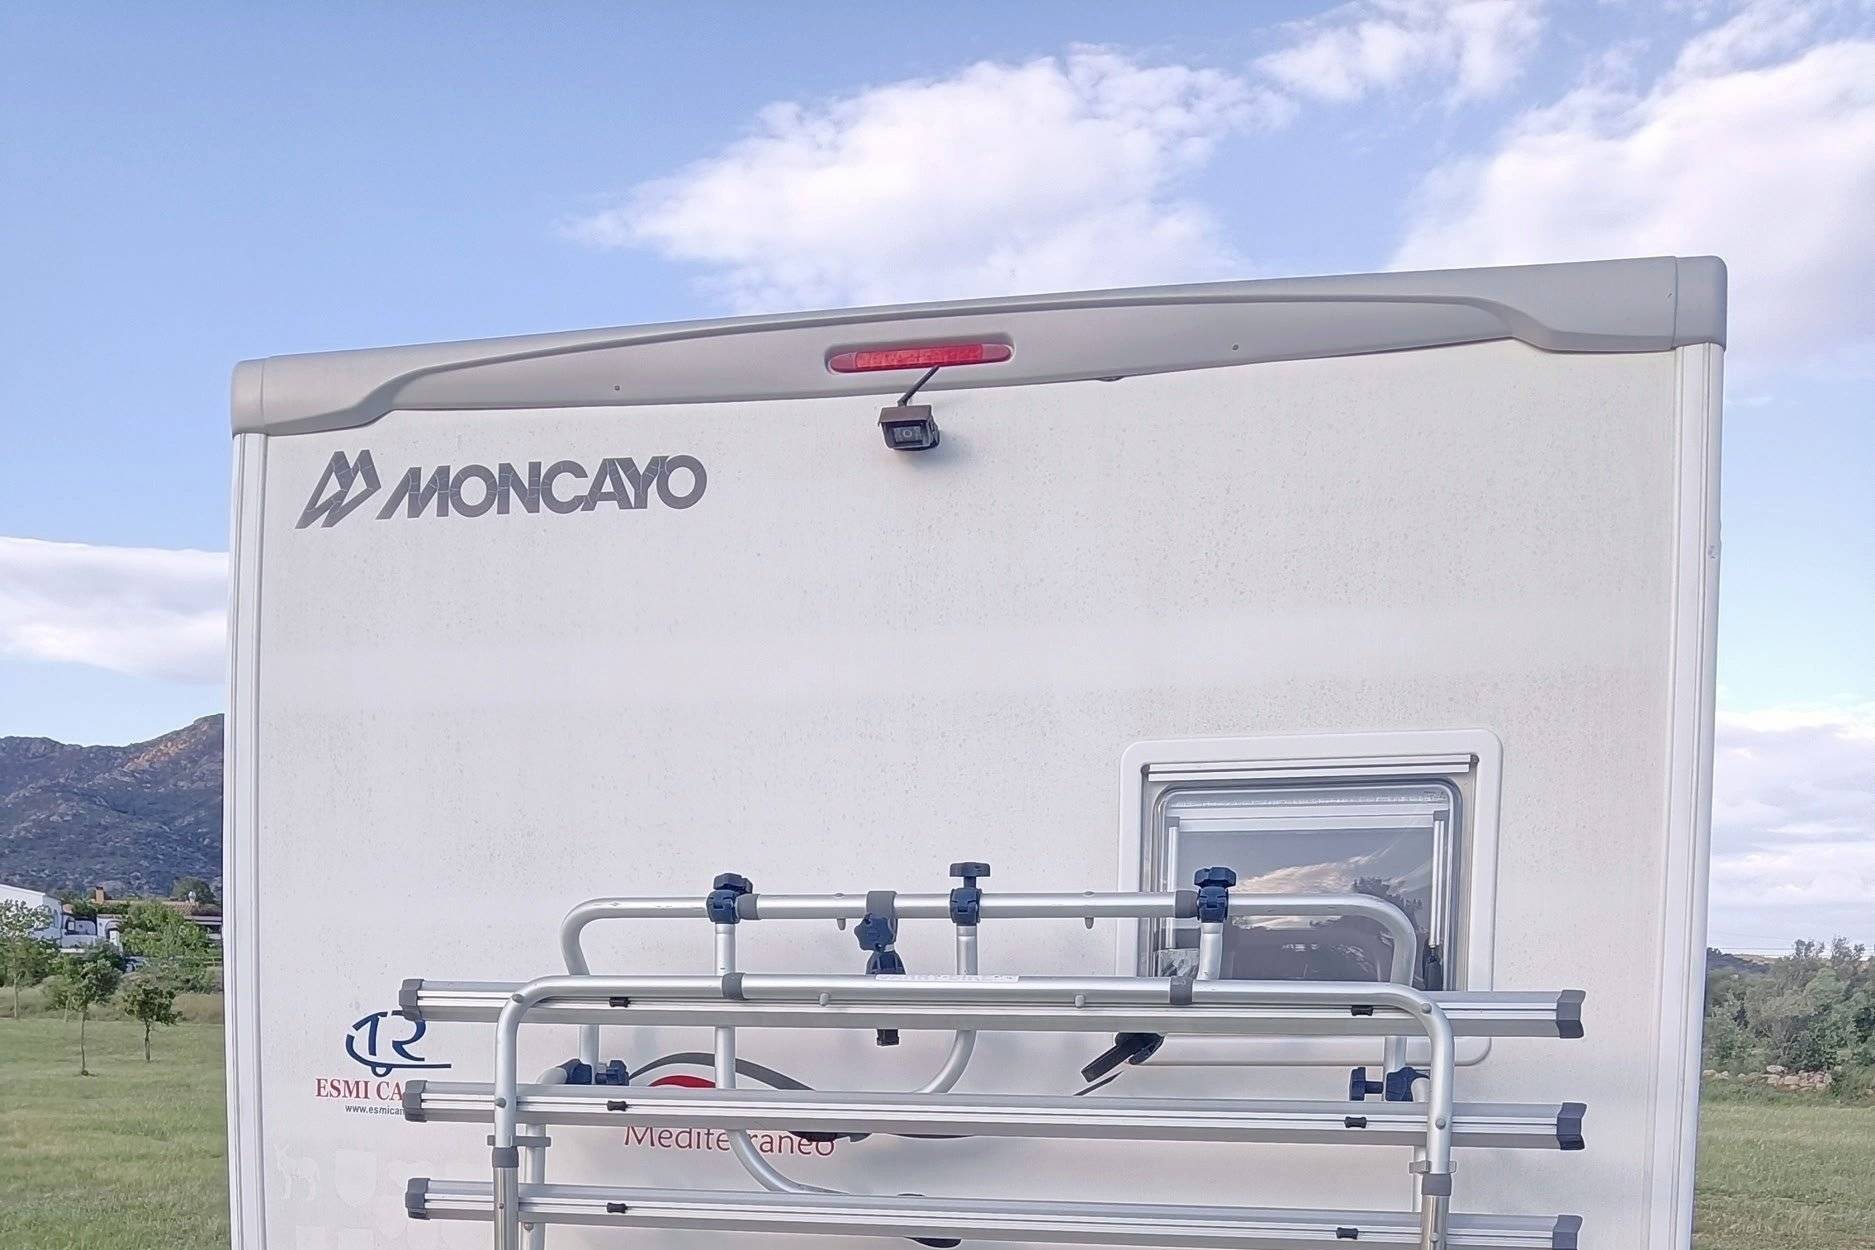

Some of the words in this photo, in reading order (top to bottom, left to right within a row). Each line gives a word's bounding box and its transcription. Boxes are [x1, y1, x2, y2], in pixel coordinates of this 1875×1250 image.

[375, 454, 708, 520] MONCAYO
[315, 1078, 371, 1100] ESMI
[376, 1081, 405, 1102] CA
[624, 1125, 835, 1157] Mediteraneo
